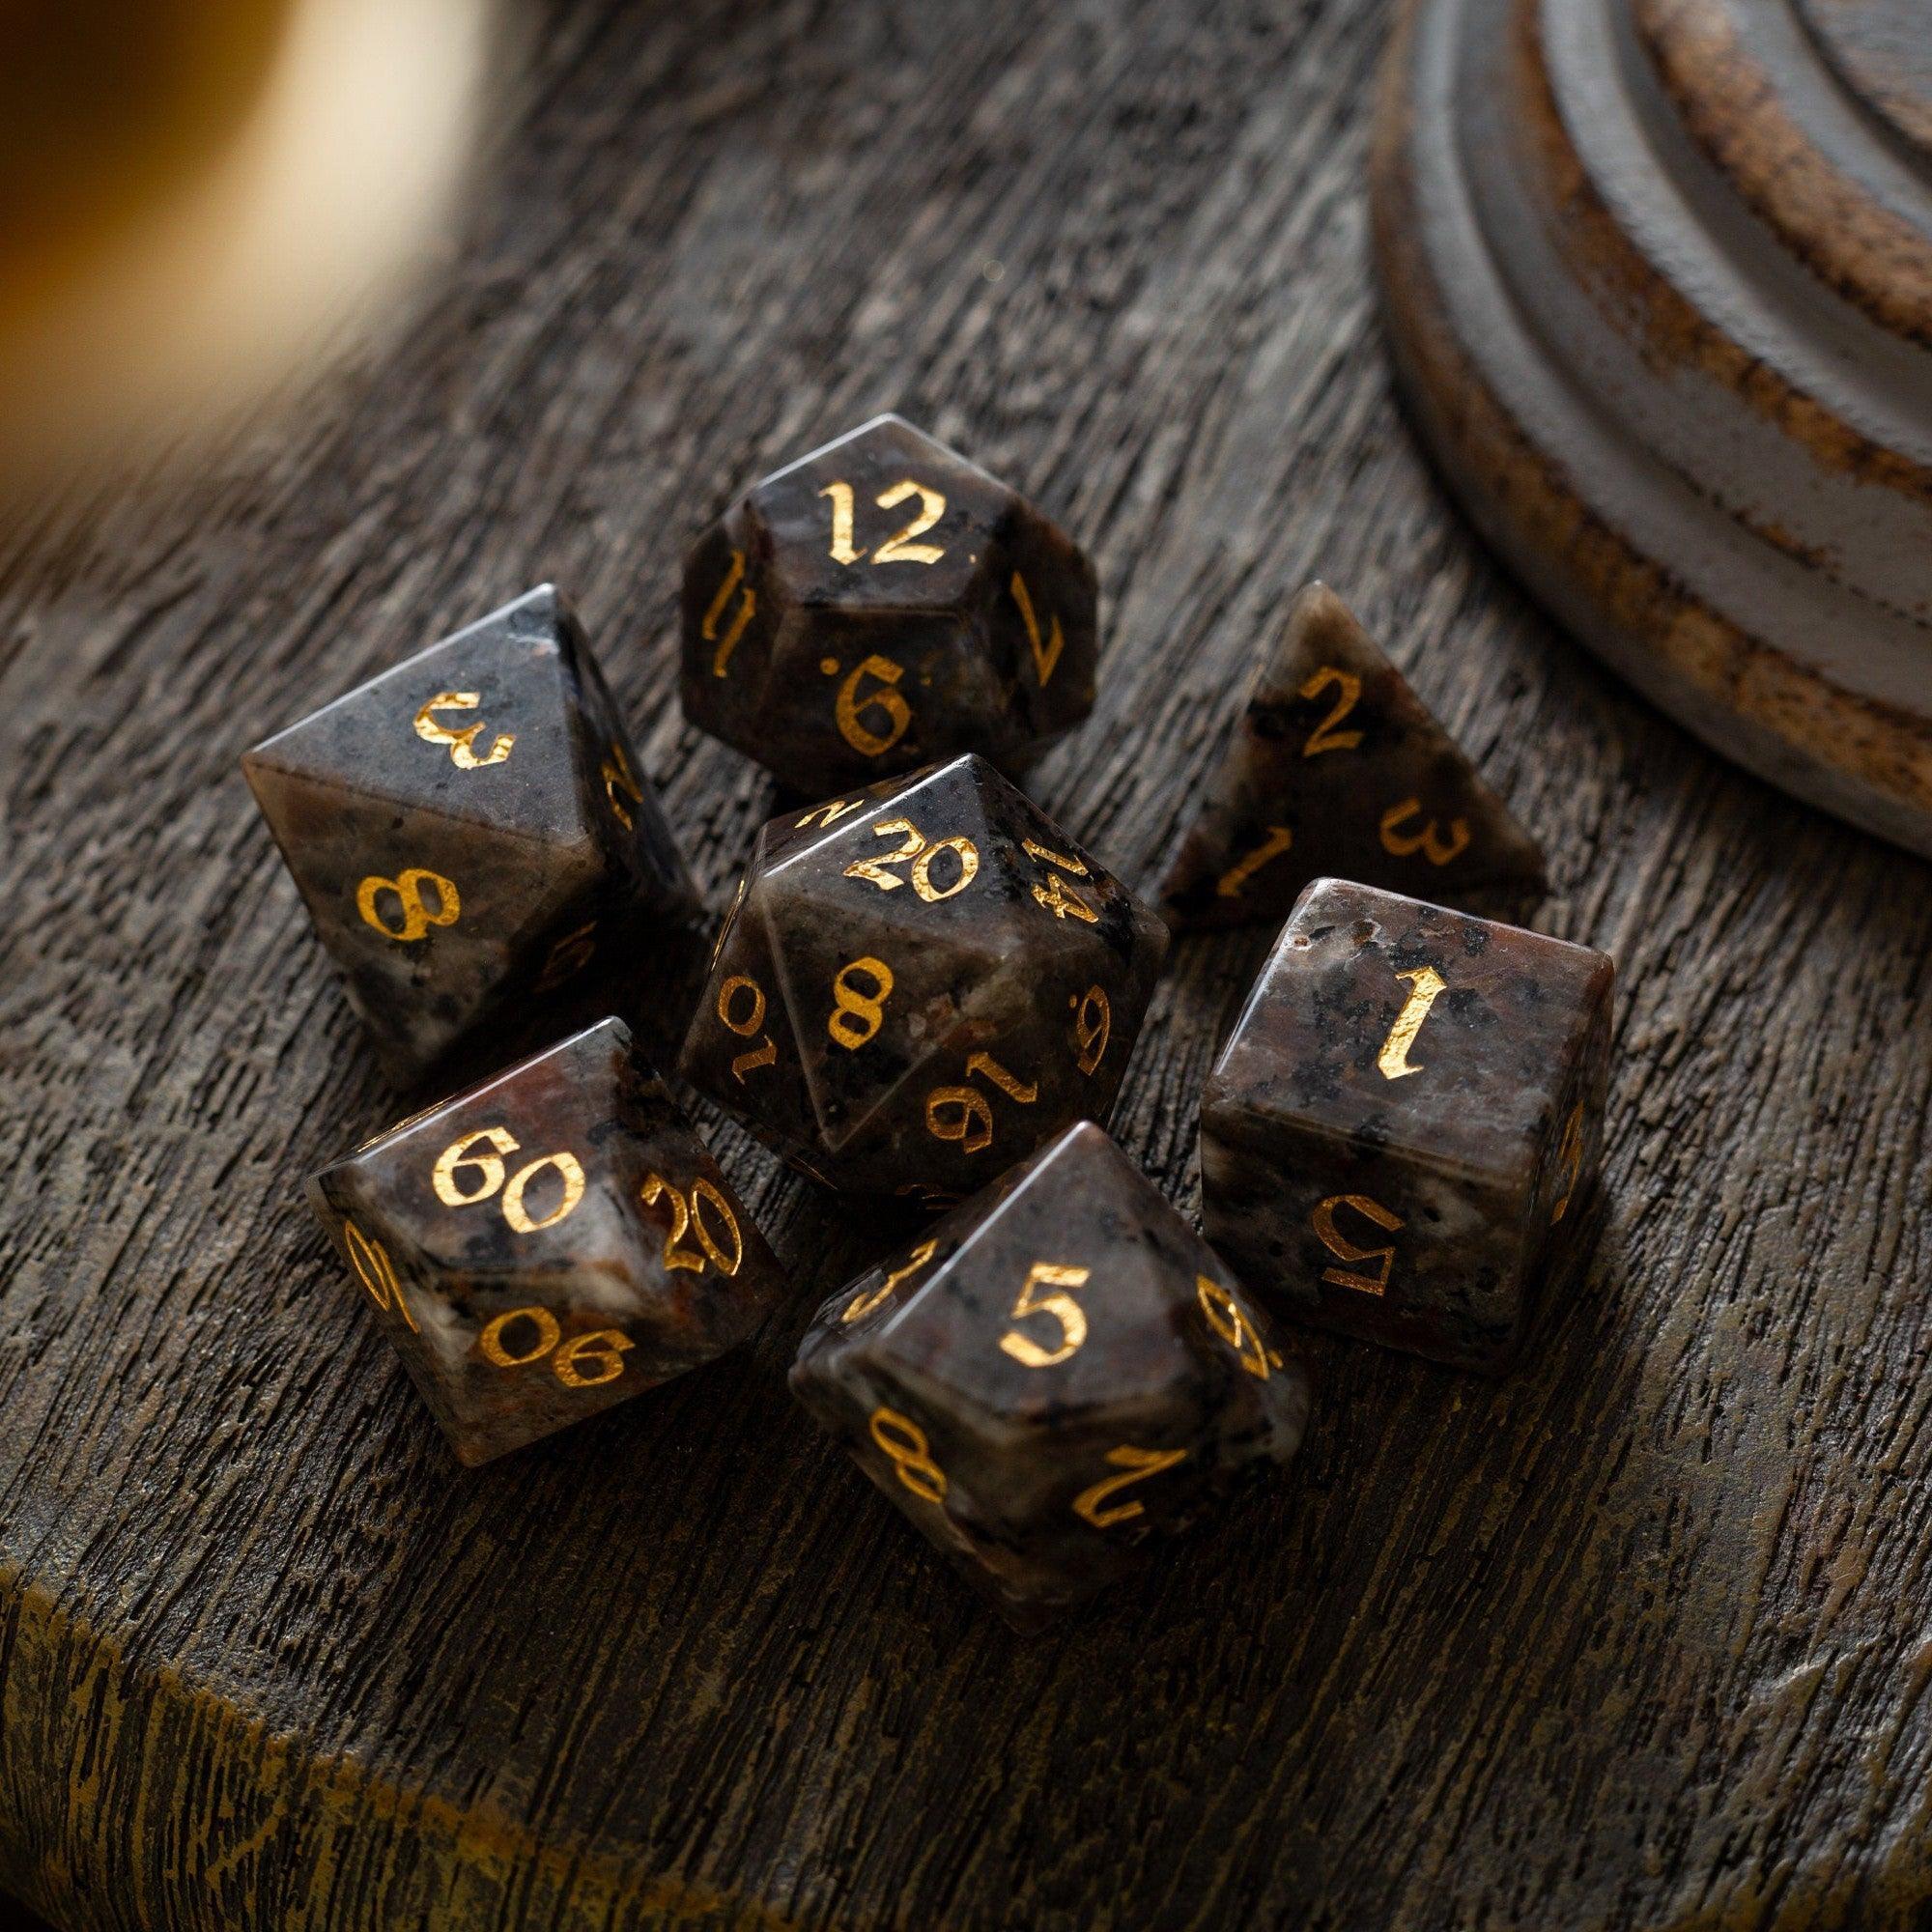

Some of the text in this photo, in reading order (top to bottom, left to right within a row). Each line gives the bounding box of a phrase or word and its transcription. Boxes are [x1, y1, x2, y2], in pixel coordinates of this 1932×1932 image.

[818, 480, 947, 566] 12
[703, 551, 755, 678] 11
[412, 692, 517, 771] 3
[1299, 666, 1365, 757] 2
[794, 800, 864, 829] 2
[843, 818, 980, 902] 20
[1380, 798, 1470, 865] 3
[356, 868, 461, 941] 8
[1022, 838, 1098, 923] 14
[1218, 826, 1292, 896] 1
[716, 974, 777, 1083] 10
[828, 956, 895, 1050] 8
[1378, 966, 1447, 1080] 1
[925, 1051, 1038, 1154] 16
[432, 1126, 585, 1234] 60
[640, 1174, 743, 1277] 20
[1313, 1194, 1404, 1296] 5
[998, 1262, 1091, 1368] 5
[870, 1406, 947, 1504] 8
[1072, 1445, 1188, 1527] 2
